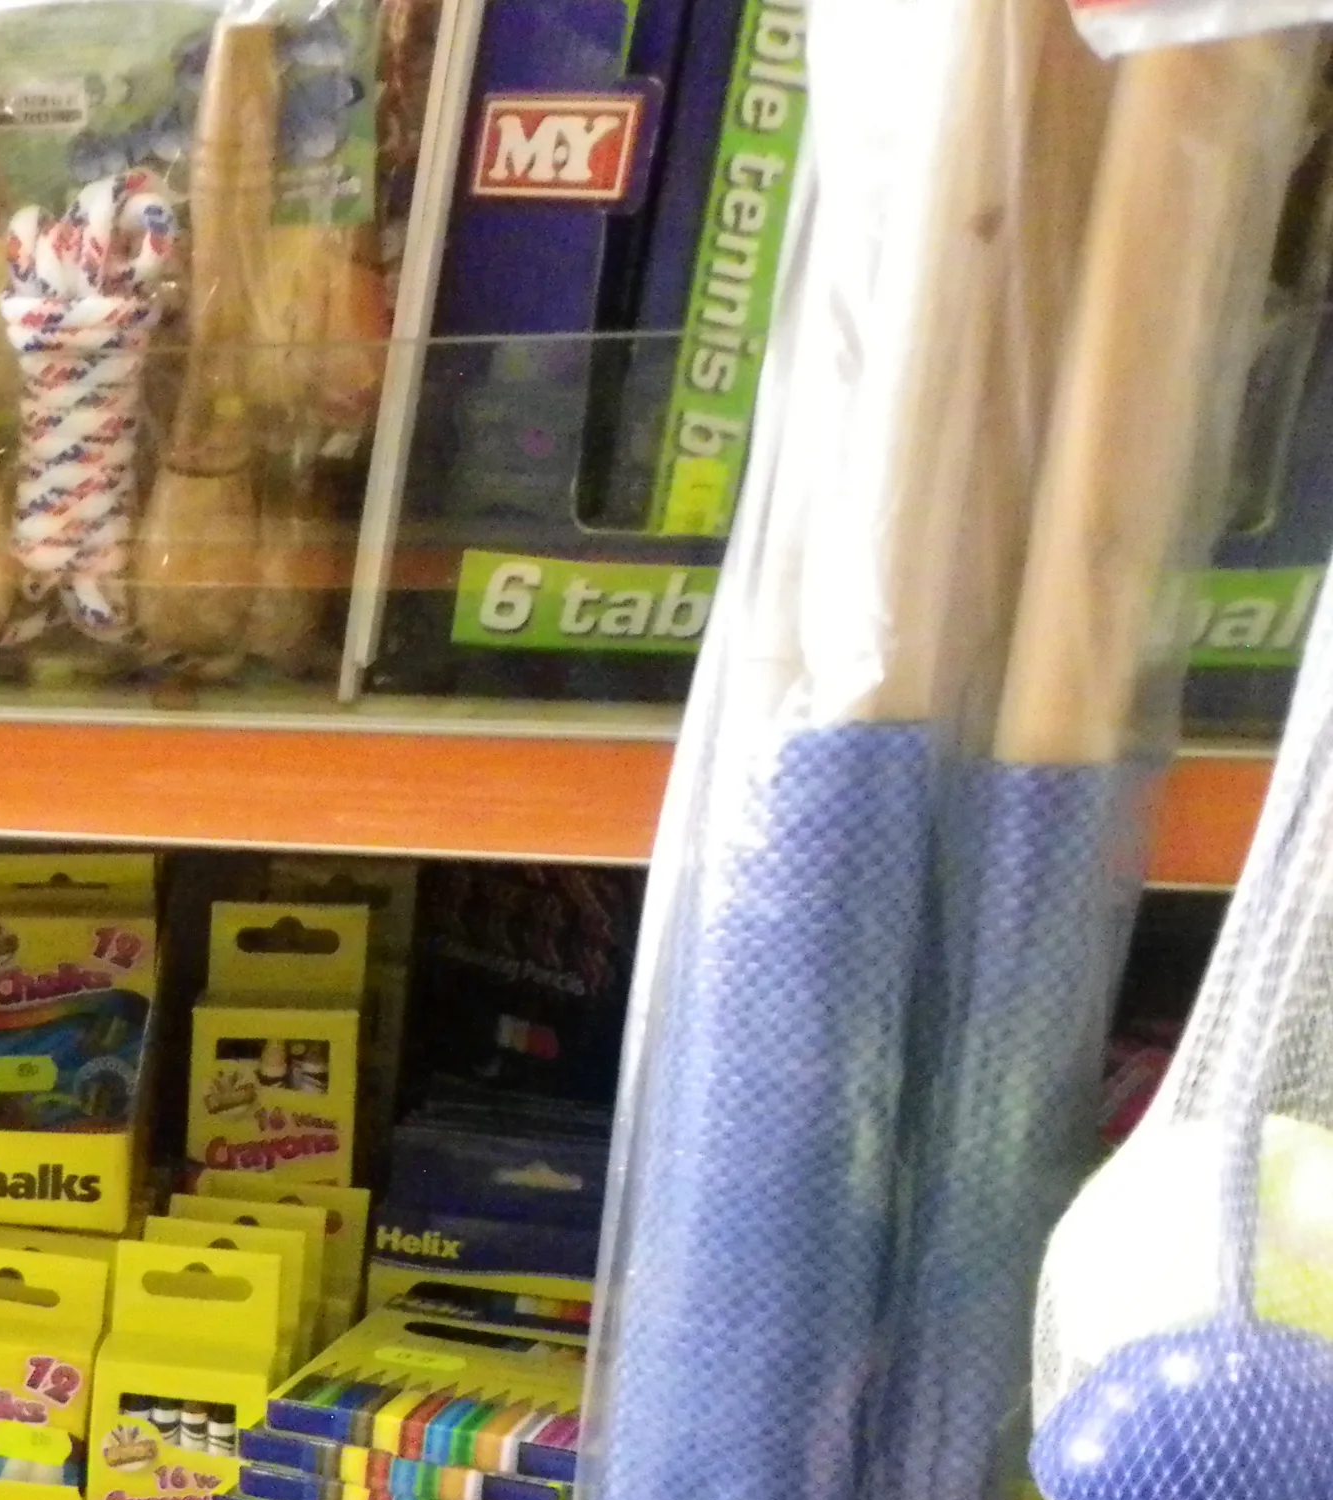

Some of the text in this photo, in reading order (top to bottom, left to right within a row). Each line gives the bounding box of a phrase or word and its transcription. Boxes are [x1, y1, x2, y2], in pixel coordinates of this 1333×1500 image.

[741, 0, 807, 133] ble
[489, 116, 617, 182] MY
[685, 150, 785, 395] tennis
[478, 562, 541, 630] 6
[92, 926, 144, 969] 12
[204, 1134, 341, 1172] Crayons
[375, 1224, 461, 1260] Helix
[24, 1356, 82, 1405] 12
[153, 1465, 188, 1490] 16
